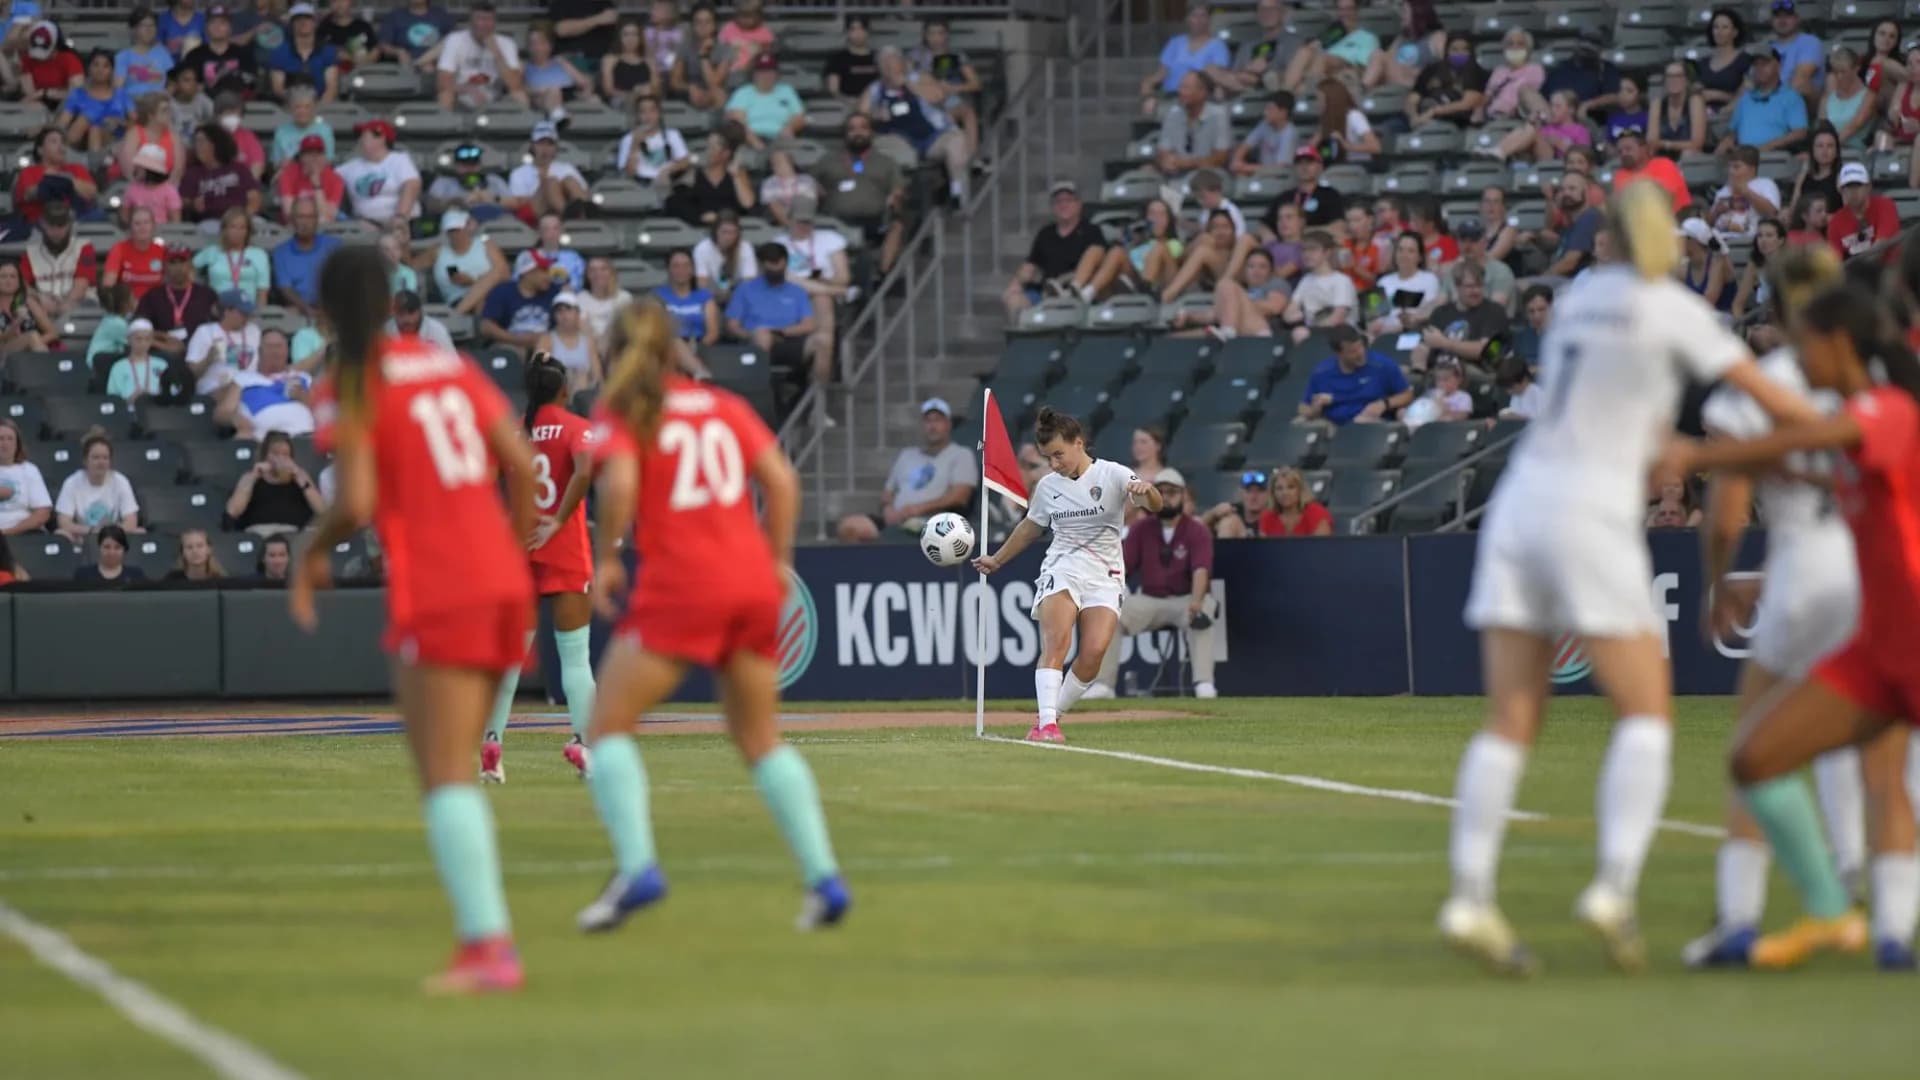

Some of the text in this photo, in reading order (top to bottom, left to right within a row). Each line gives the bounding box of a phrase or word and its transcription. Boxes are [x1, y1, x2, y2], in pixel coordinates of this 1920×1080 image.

[409, 387, 486, 488] 13
[659, 419, 744, 510] 20
[1051, 506, 1098, 520] Continental
